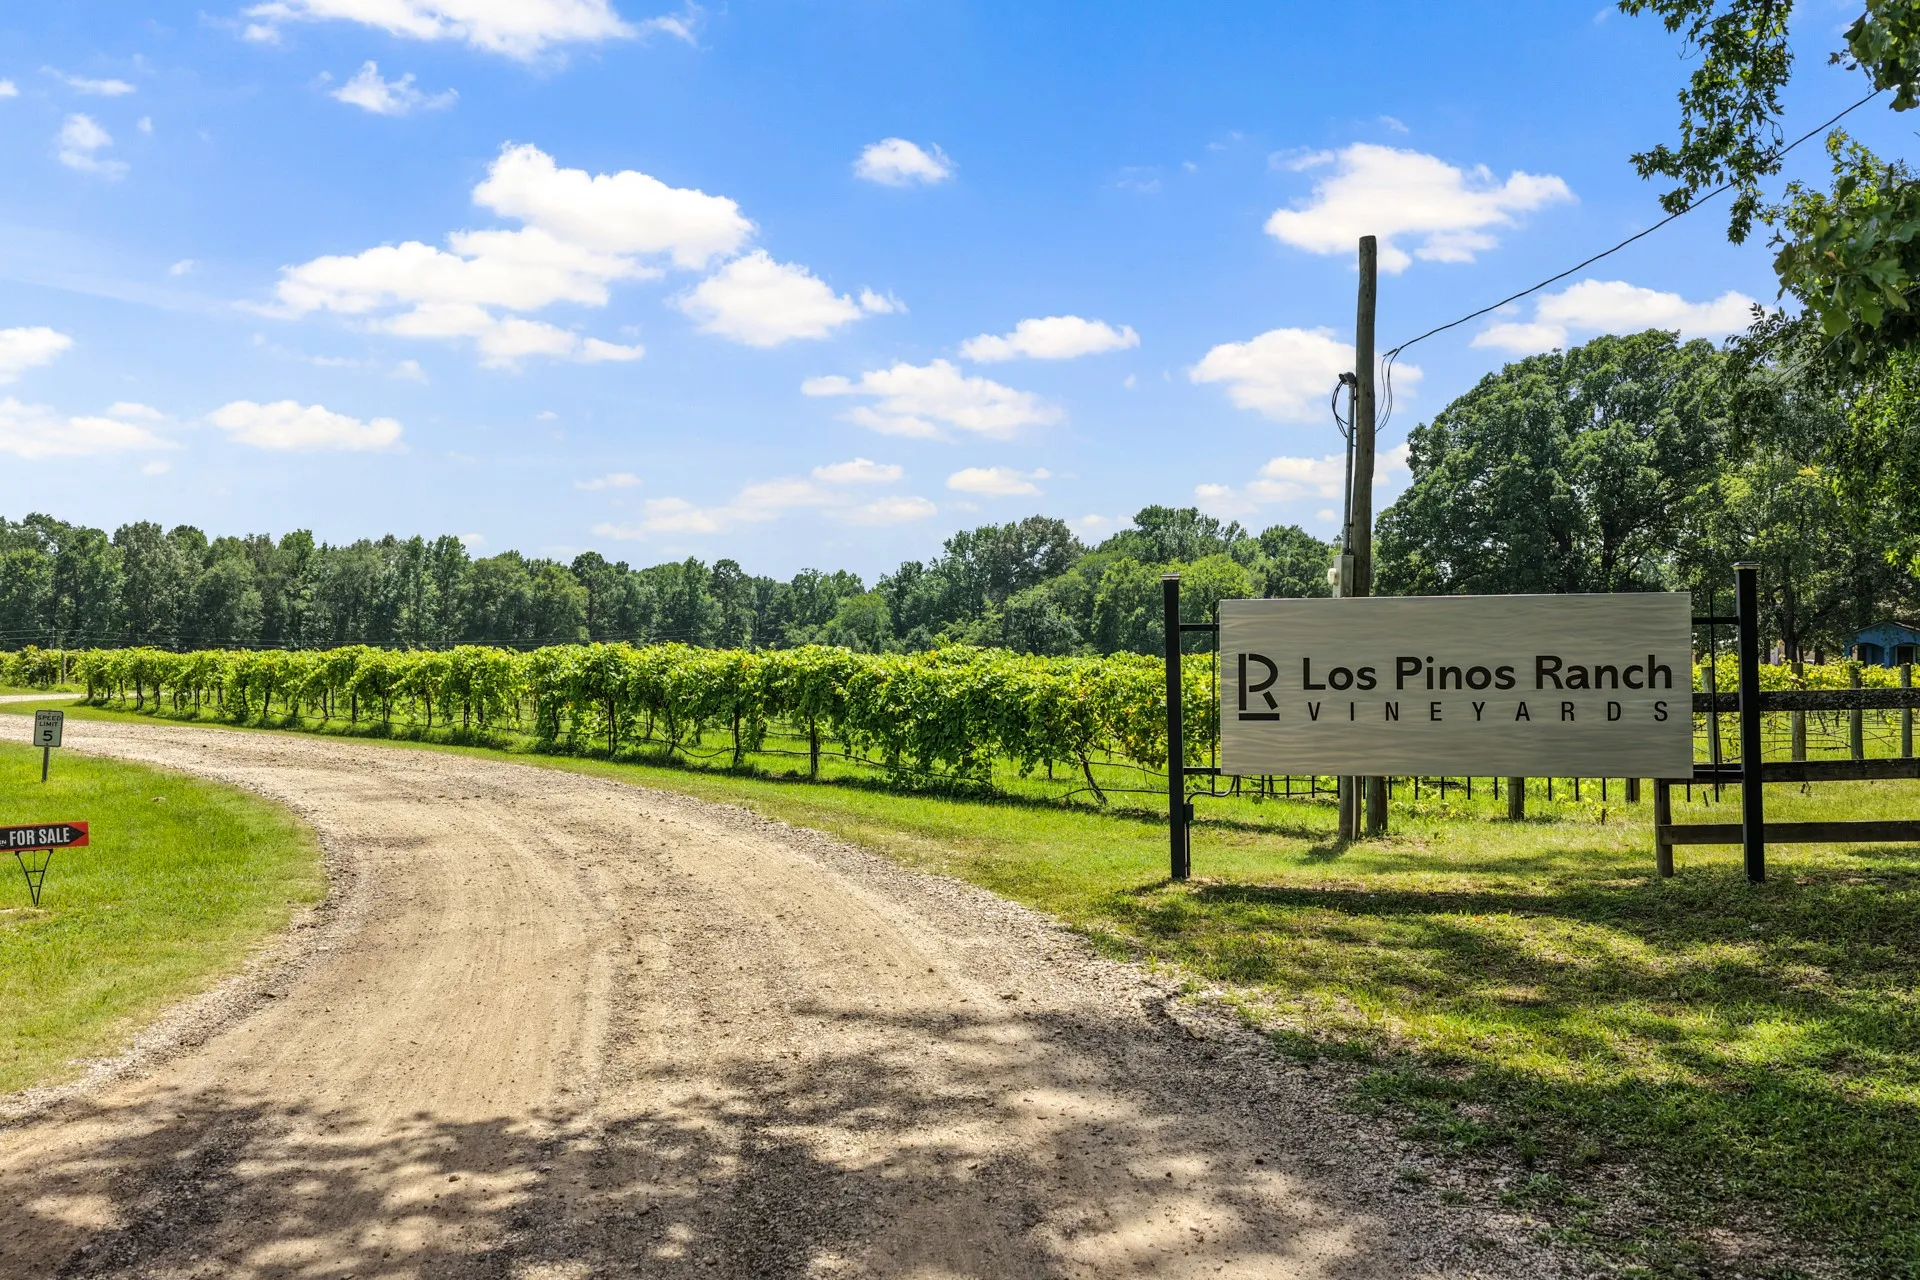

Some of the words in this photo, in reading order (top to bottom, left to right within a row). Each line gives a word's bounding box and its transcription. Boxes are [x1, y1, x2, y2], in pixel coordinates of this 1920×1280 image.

[1302, 657, 1377, 691] Los
[1395, 655, 1516, 691] Pinos
[1535, 654, 1673, 690] Ranch
[1307, 700, 1669, 722] VINEYARDS
[42, 730, 53, 741] 5
[9, 830, 35, 846] FOR
[38, 827, 71, 844] SALE
